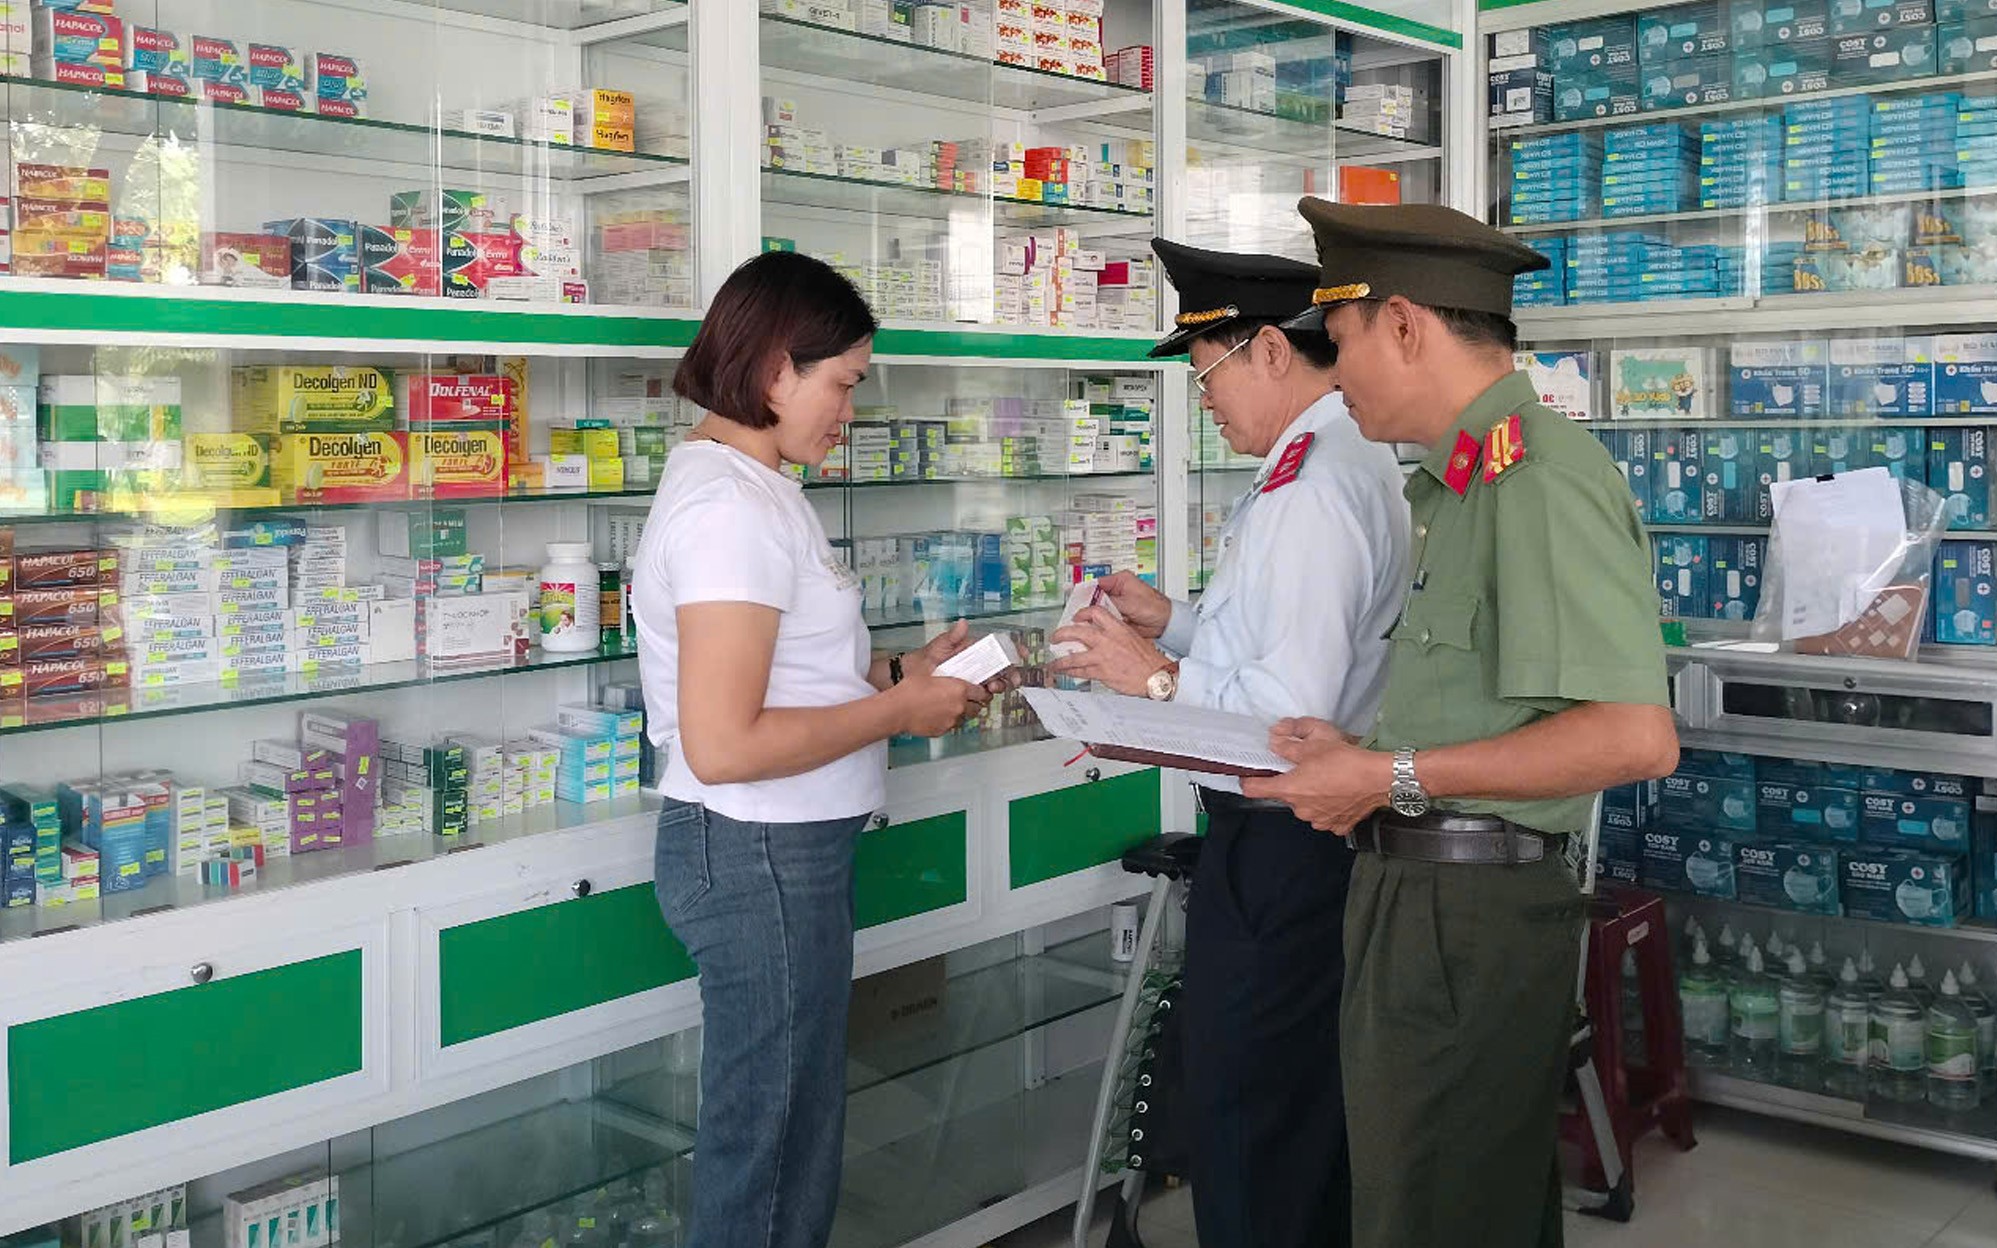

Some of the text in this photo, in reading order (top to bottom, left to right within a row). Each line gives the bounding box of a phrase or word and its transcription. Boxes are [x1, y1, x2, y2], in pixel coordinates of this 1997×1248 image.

[55, 19, 104, 34] HAPACOL
[58, 68, 105, 83] HAPACOL
[294, 373, 378, 393] Decolgen ND
[309, 436, 382, 459] Decolgen
[424, 435, 488, 457] Decolgen
[21, 556, 75, 567] HAPACOL
[69, 567, 95, 578] 650
[21, 591, 75, 604] HAPACOL
[69, 603, 95, 614] 650
[26, 626, 81, 639] HAPACOL
[73, 638, 100, 649] 650
[32, 660, 86, 675] HAPACOL
[78, 673, 106, 684] 650
